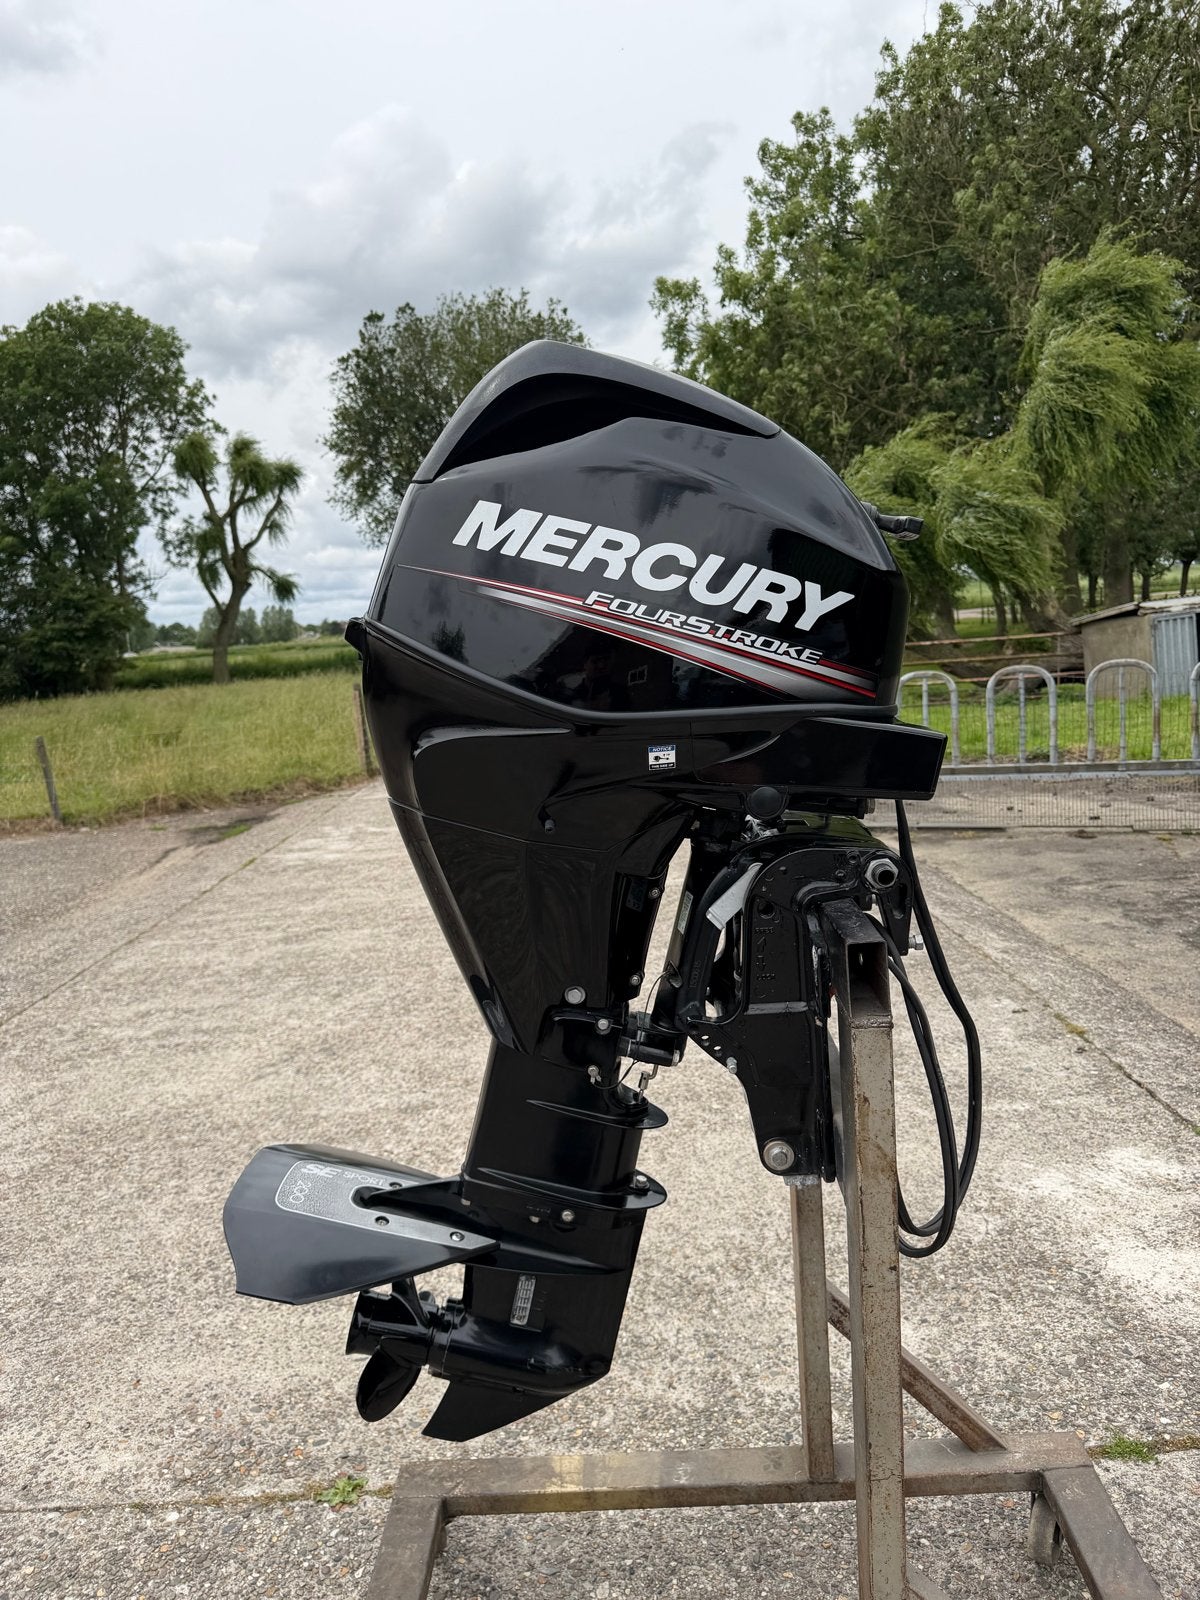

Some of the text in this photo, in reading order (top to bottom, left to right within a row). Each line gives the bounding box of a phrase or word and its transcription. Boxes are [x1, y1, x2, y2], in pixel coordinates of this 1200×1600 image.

[452, 499, 855, 632] MERCURY
[584, 590, 823, 665] FOURSTROKE
[301, 1164, 385, 1187] SE SPORT
